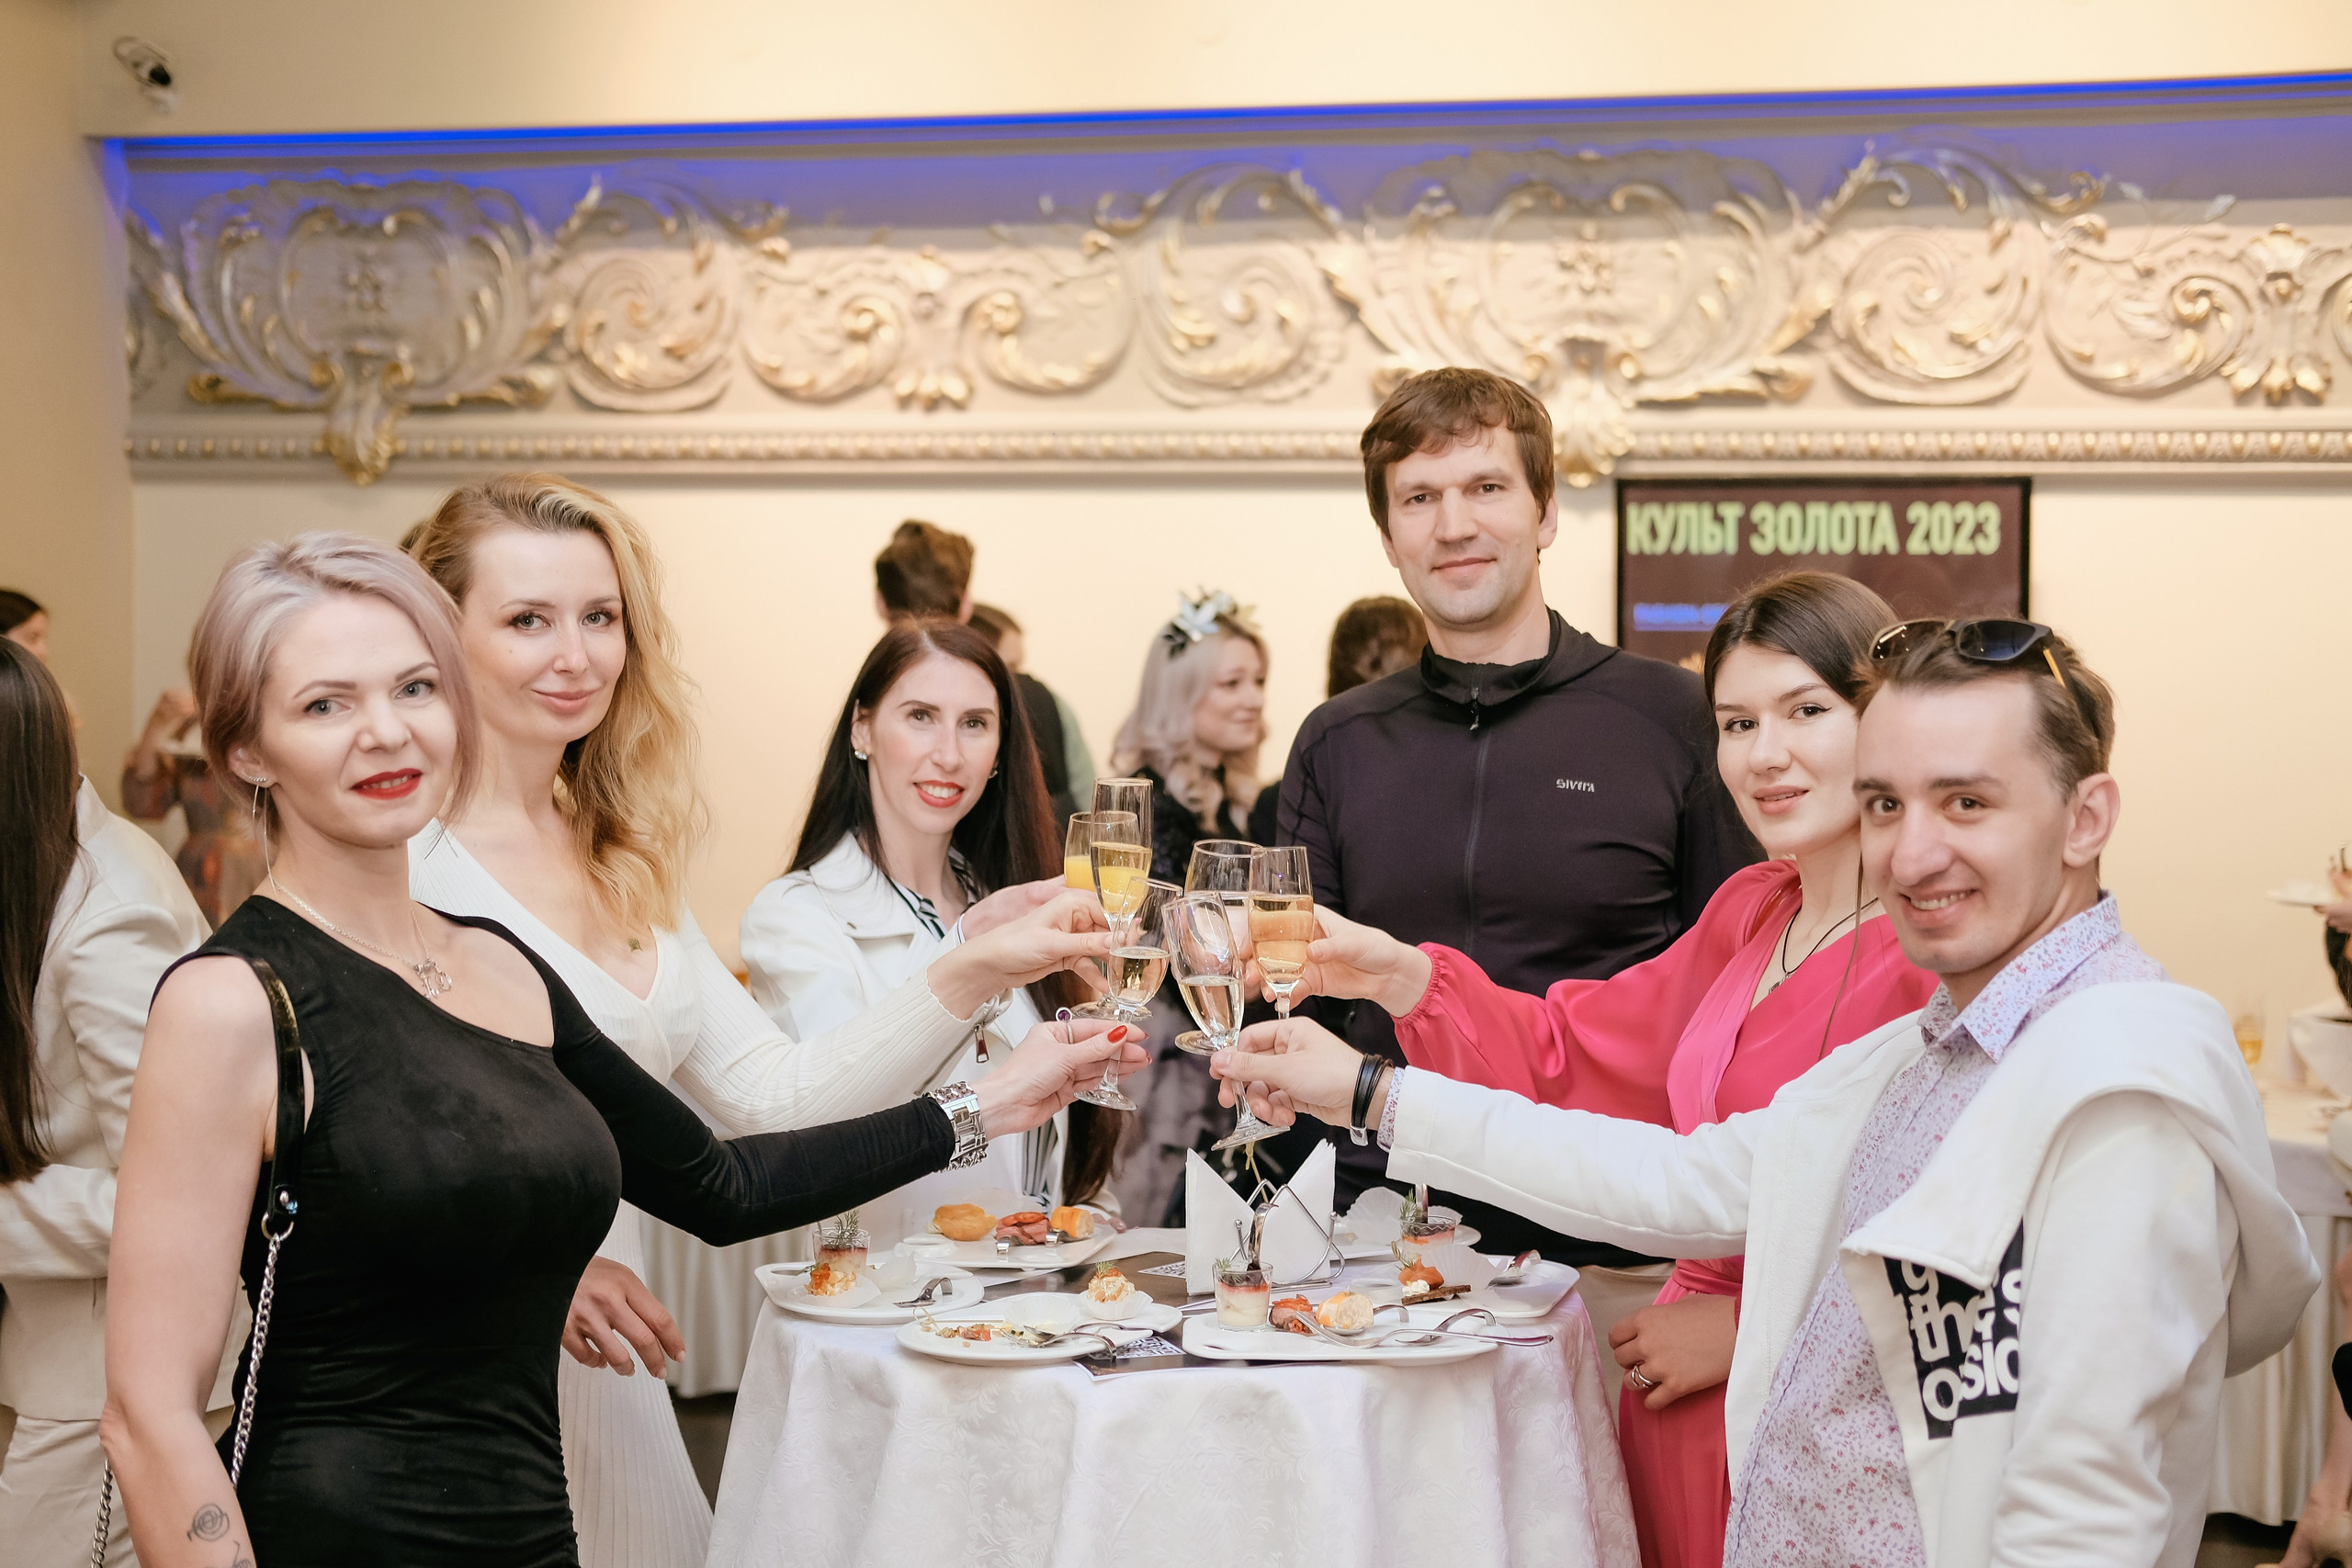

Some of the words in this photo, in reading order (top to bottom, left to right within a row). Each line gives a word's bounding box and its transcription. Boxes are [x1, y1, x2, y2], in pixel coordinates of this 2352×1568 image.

[1625, 501, 1745, 555] КУЛЬТ
[1749, 501, 1899, 555] ЗОЛОТА
[1905, 501, 2001, 555] 2023
